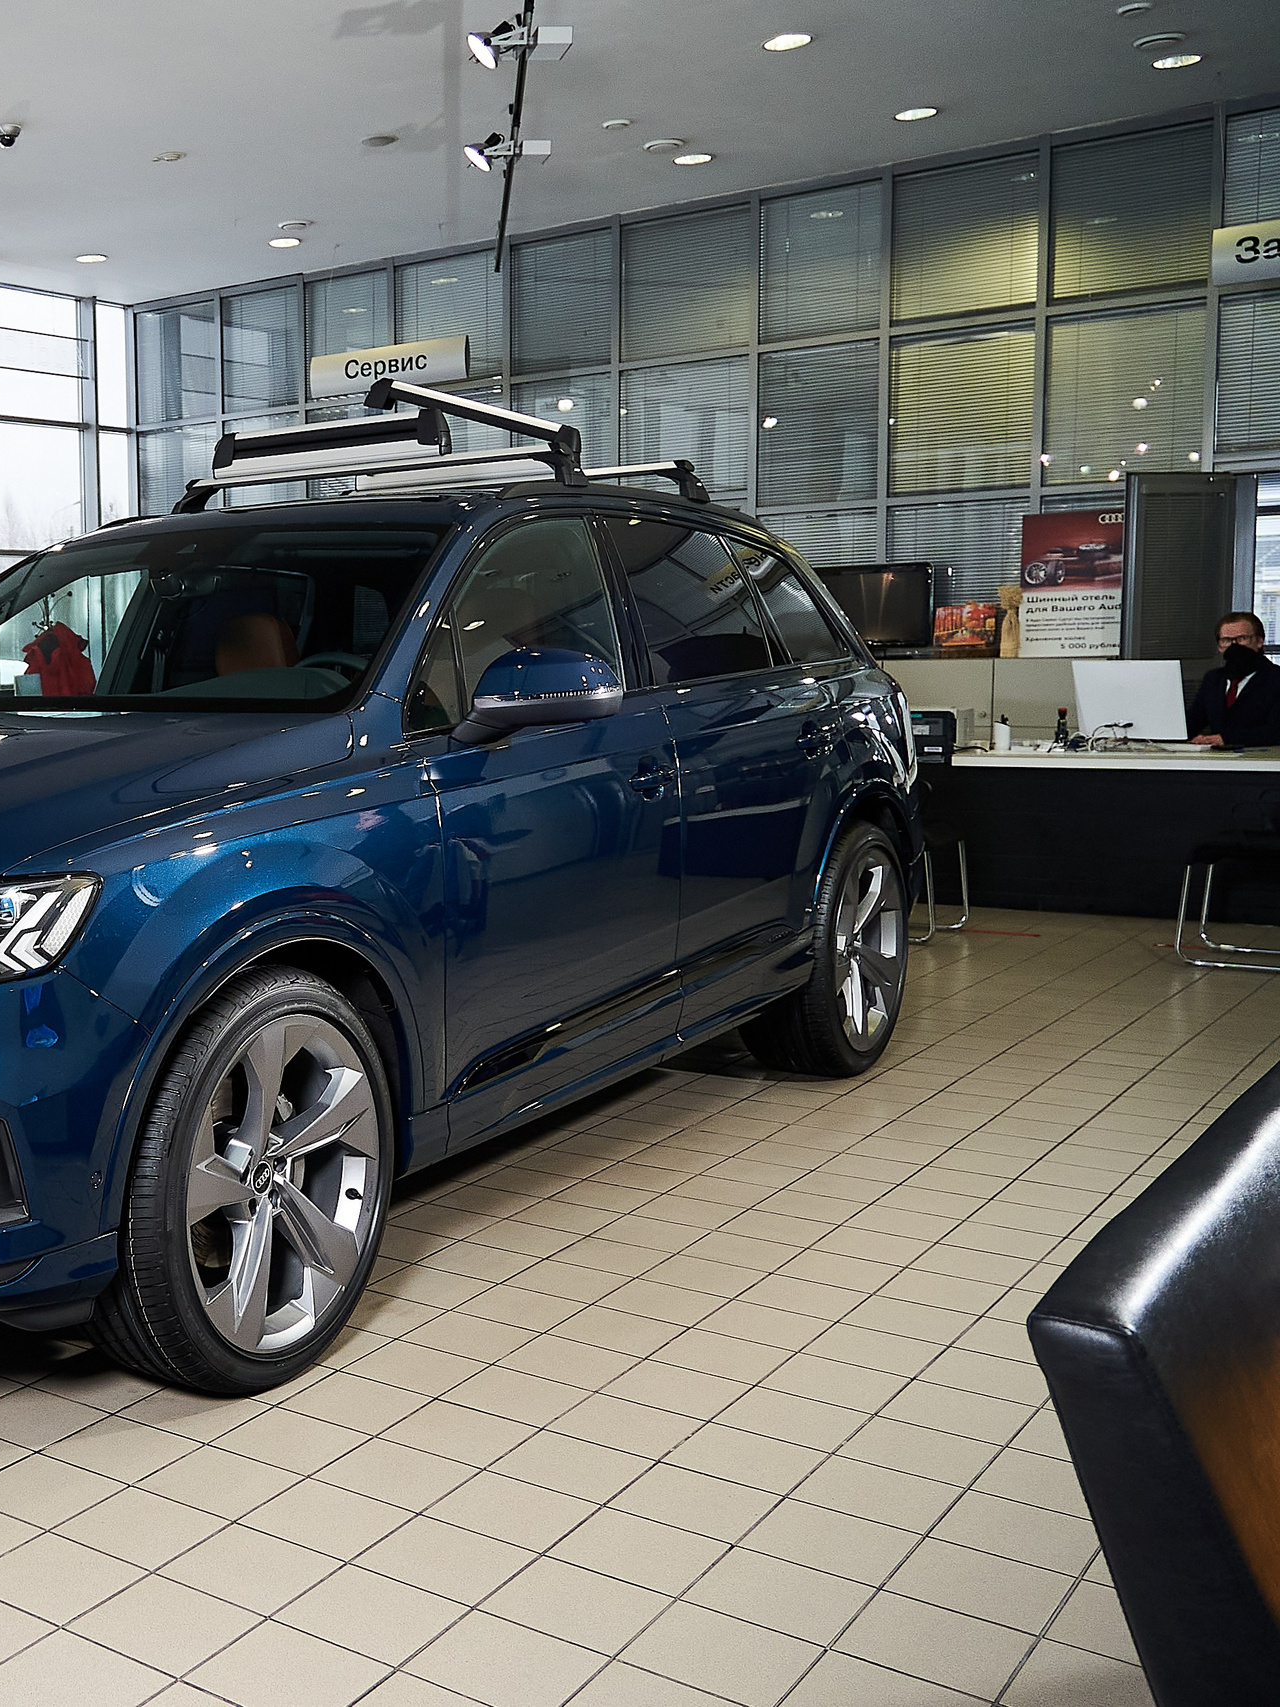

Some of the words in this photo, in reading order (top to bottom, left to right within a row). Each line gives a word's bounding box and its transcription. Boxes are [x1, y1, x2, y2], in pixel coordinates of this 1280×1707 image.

[1235, 236, 1280, 263] За
[344, 354, 428, 381] Сервис
[1026, 594, 1079, 603] Шинный
[1081, 594, 1116, 602] отель
[1025, 606, 1048, 614] для
[1051, 604, 1096, 612] Вашего
